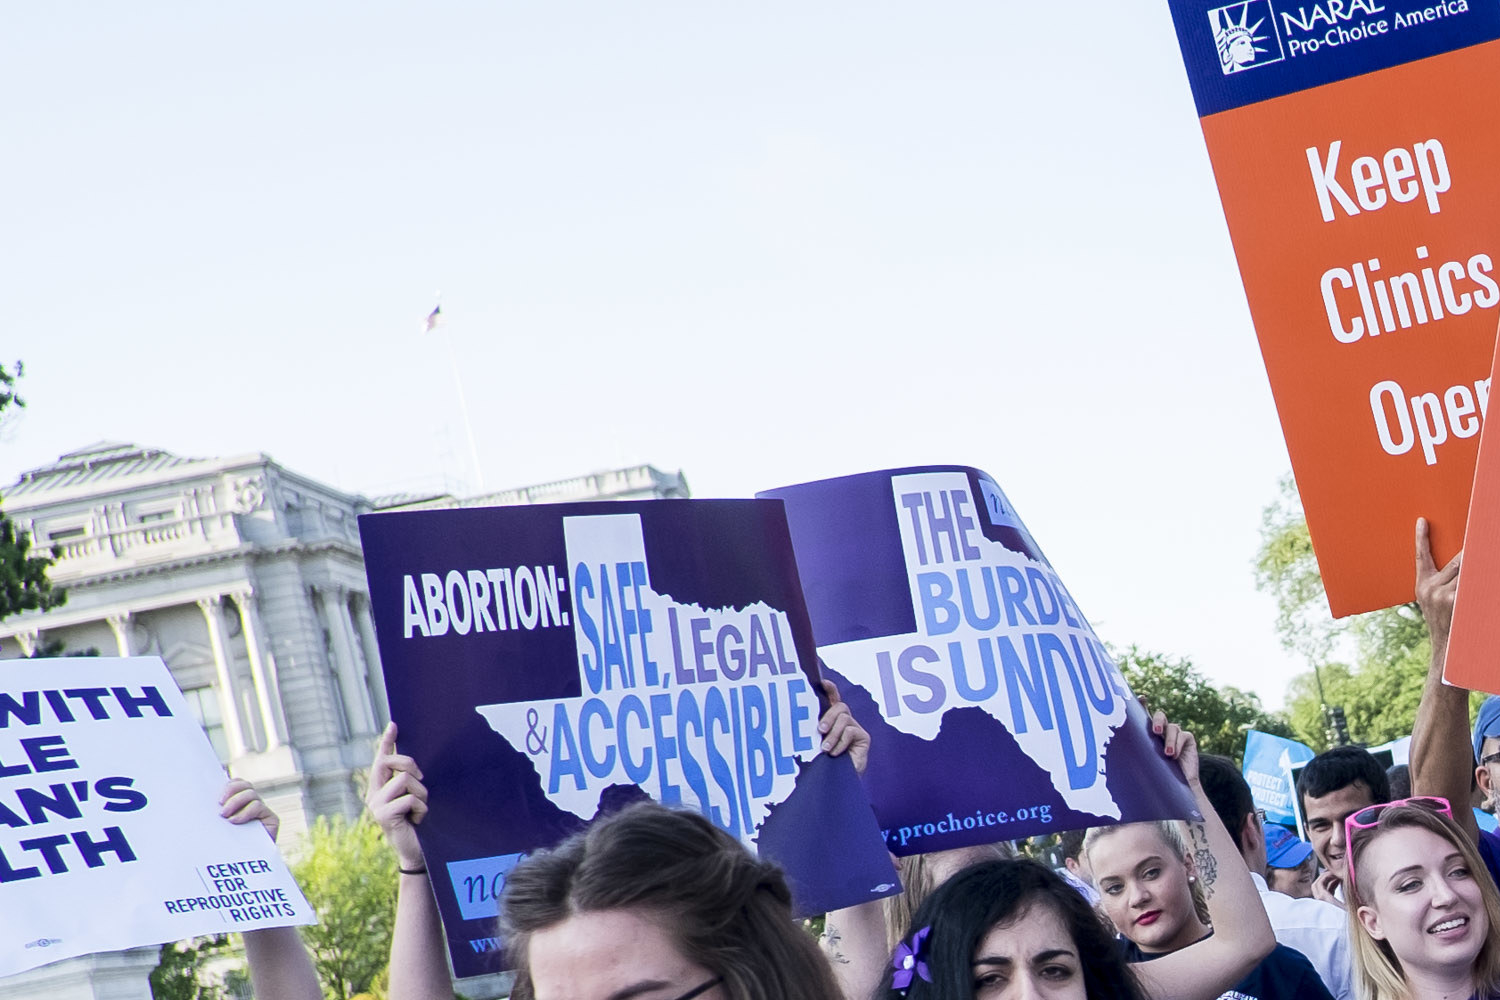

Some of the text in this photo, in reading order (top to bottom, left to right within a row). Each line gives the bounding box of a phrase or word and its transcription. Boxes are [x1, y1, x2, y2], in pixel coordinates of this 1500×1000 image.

[1281, 0, 1385, 36] NARAL
[1288, 0, 1469, 57] Pro-Choice America
[1306, 138, 1452, 223] Keep
[1320, 245, 1500, 344] Clinics
[900, 489, 981, 566] THE
[403, 565, 570, 638] ABORTION:
[574, 561, 799, 695] SAFE, LEGAL
[916, 565, 1088, 637] BURDE
[875, 644, 947, 719] IS
[525, 678, 813, 838] & ACCESSIBLE
[164, 888, 288, 914] REPRODUCTIVE
[206, 859, 273, 879] CENTER
[214, 877, 249, 893] FOR
[230, 903, 296, 923] RIGHTS
